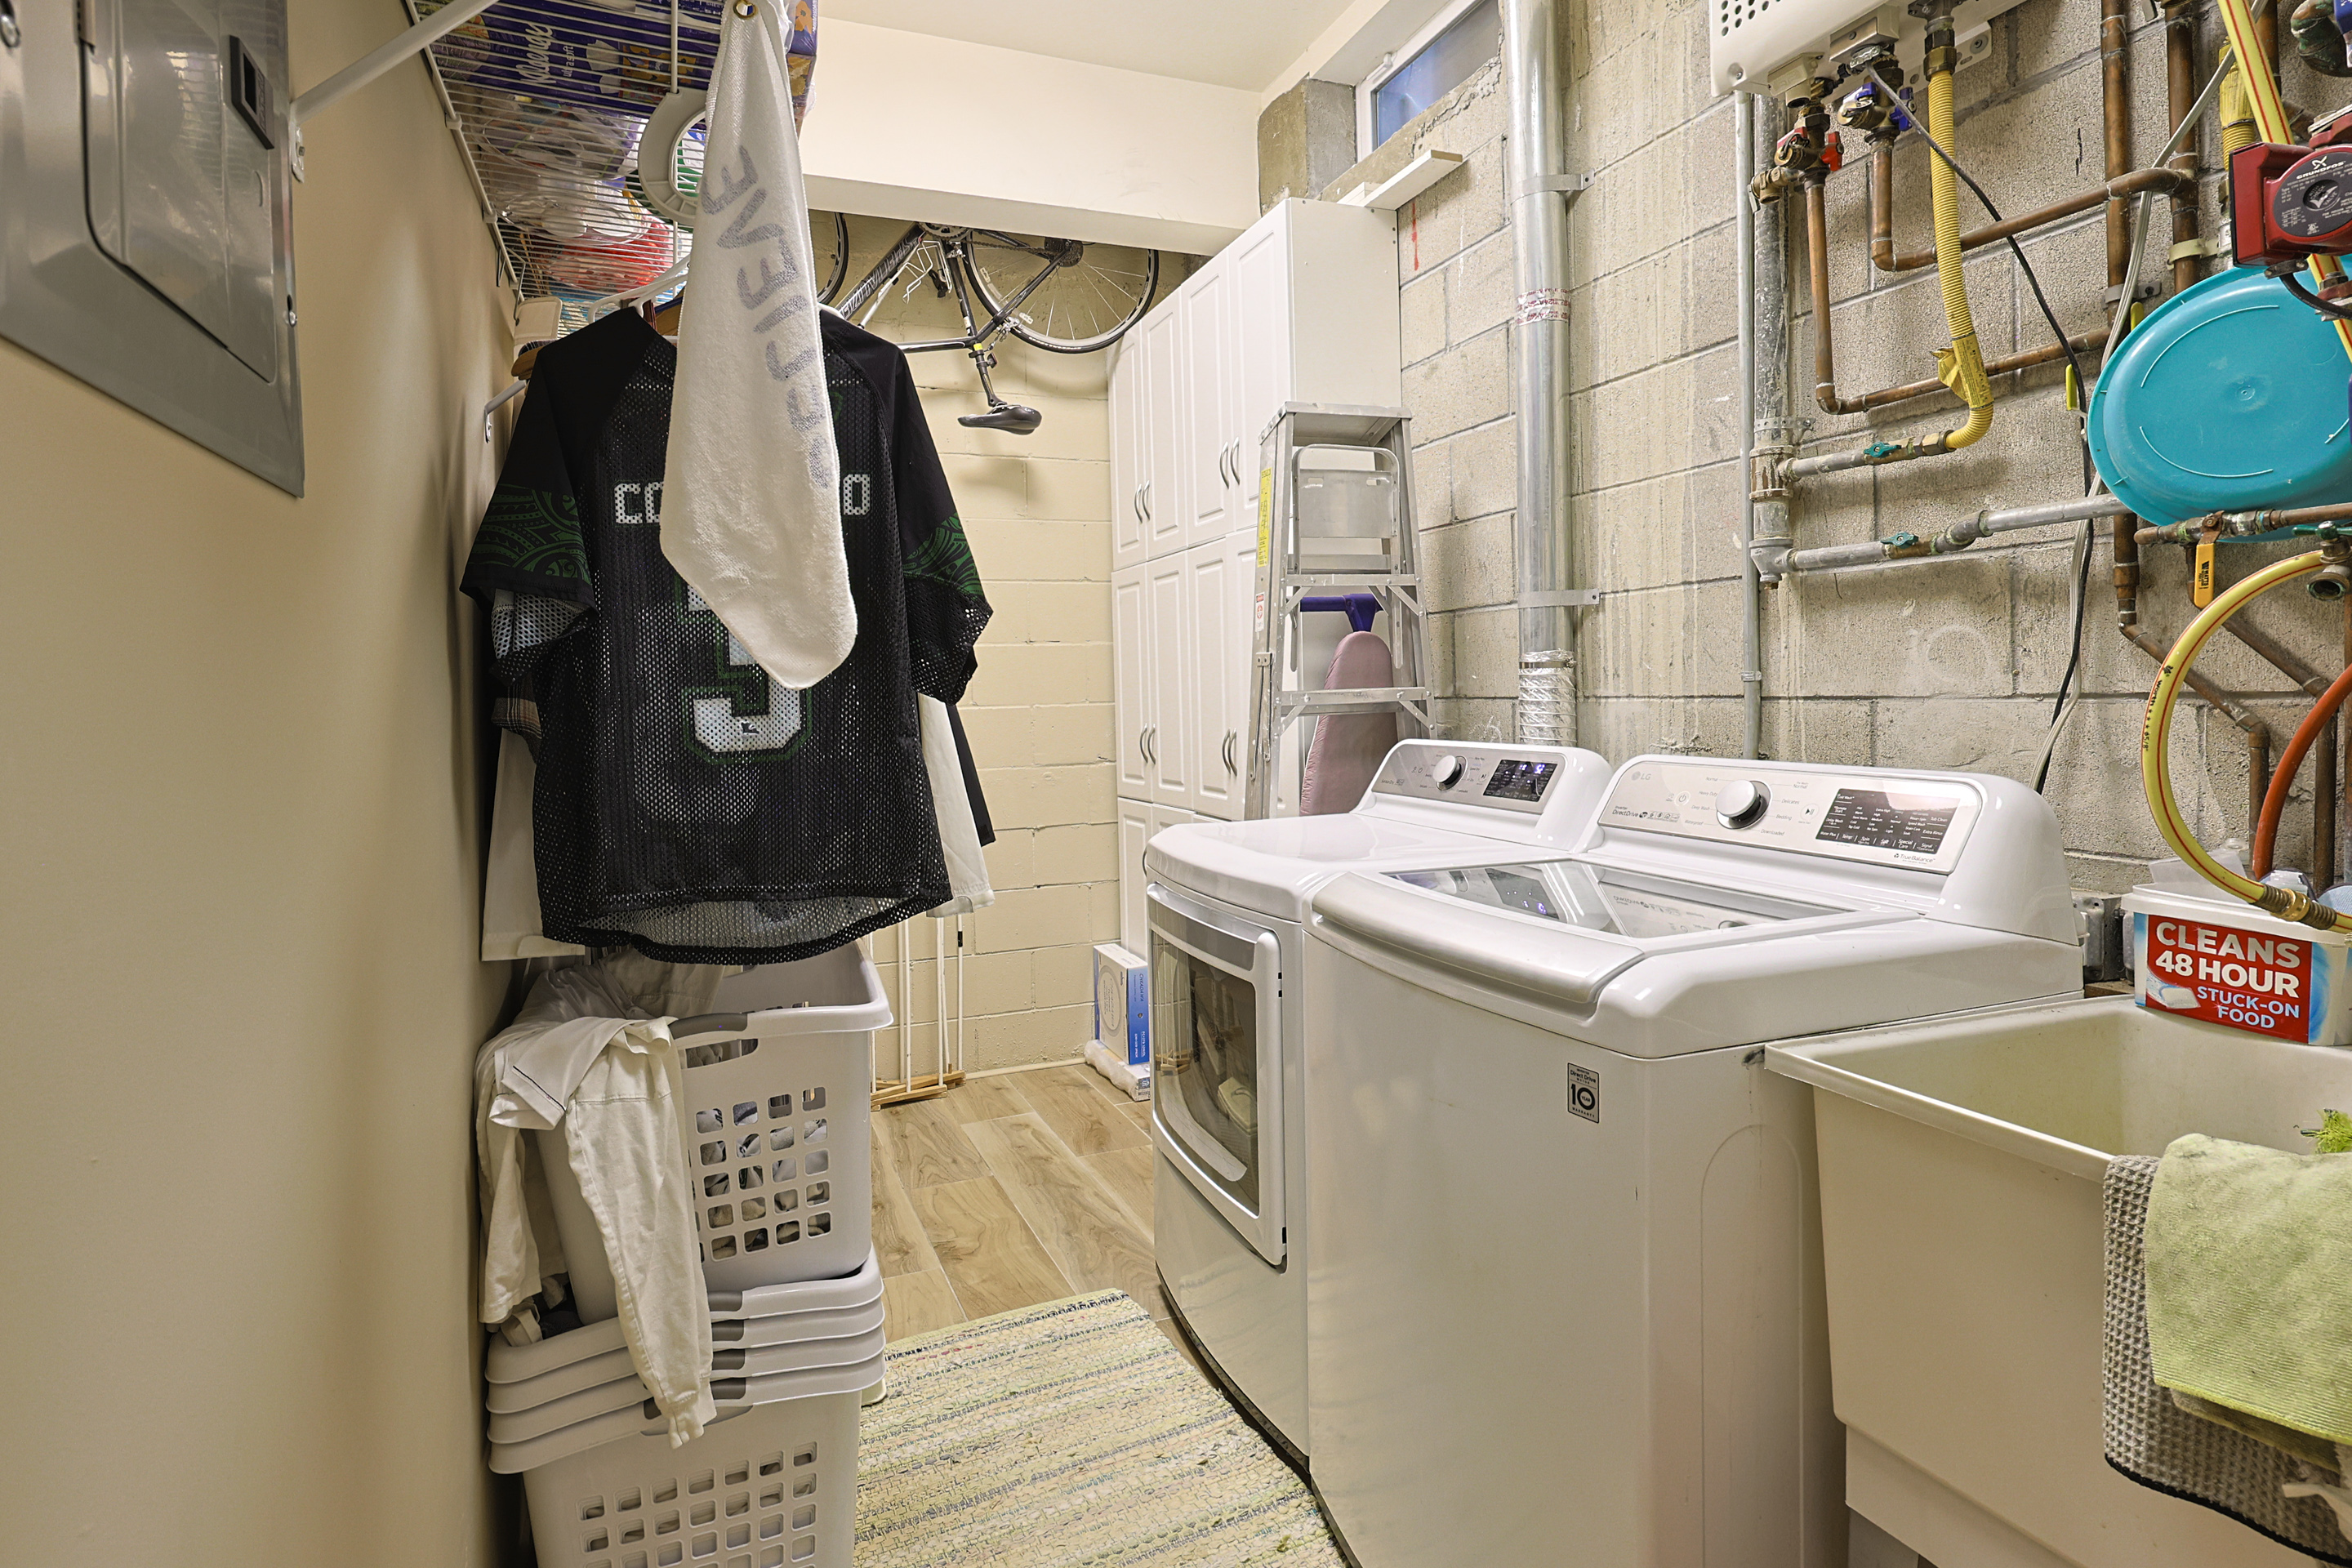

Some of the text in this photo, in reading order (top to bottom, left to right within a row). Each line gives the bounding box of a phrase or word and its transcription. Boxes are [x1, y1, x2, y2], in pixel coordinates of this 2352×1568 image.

[515, 21, 557, 83] Kleenex
[561, 62, 575, 78] ula
[2296, 161, 2345, 180] GRUNDFOS
[2310, 185, 2325, 200] CHECK
[2323, 191, 2338, 206] VALVE
[838, 234, 913, 320] SPECIALIZE
[2155, 921, 2301, 969] CLEANS
[2155, 951, 2301, 999] 48 HOUR
[2197, 985, 2301, 1019] STUCK-ON
[2216, 1005, 2275, 1029] FOOD
[1570, 1070, 1583, 1078] Direct
[1584, 1075, 1596, 1083] Drive
[1571, 1084, 1595, 1110] 10
[1571, 1107, 1595, 1118] WARRANTY
